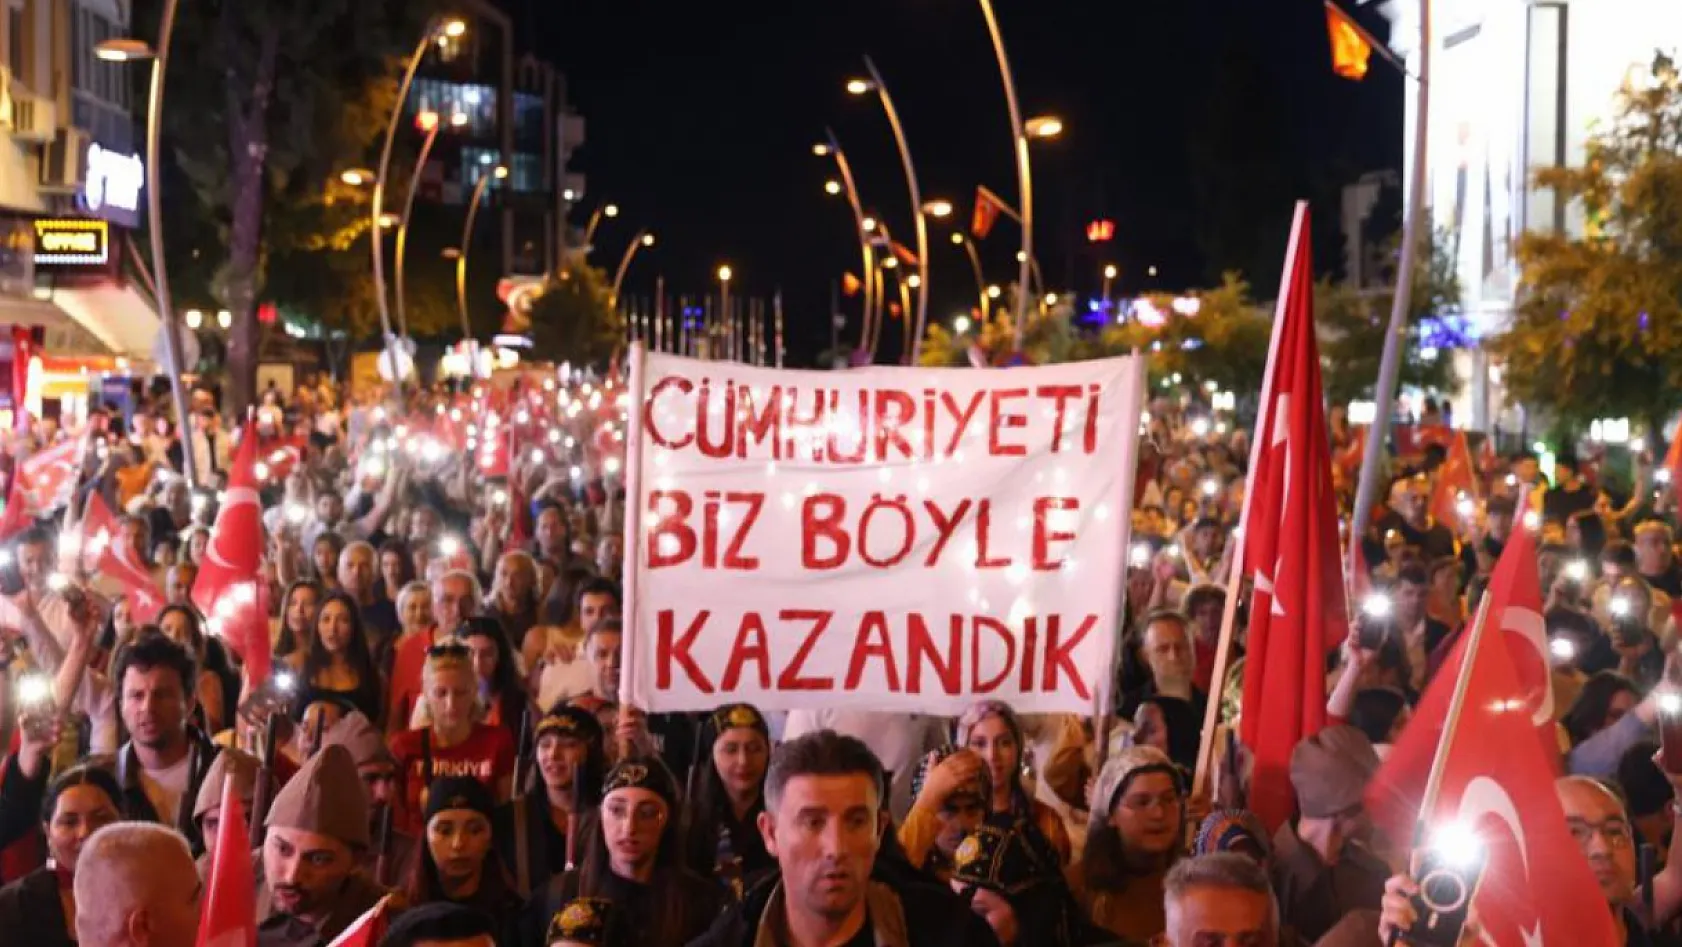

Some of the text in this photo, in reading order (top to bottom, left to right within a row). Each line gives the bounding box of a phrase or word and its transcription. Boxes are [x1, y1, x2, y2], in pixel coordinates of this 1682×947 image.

[642, 376, 1101, 465] CÜMHURİYETİ
[647, 490, 1079, 571] BİZ BÖYLE
[655, 608, 1099, 701] KAZANDIK
